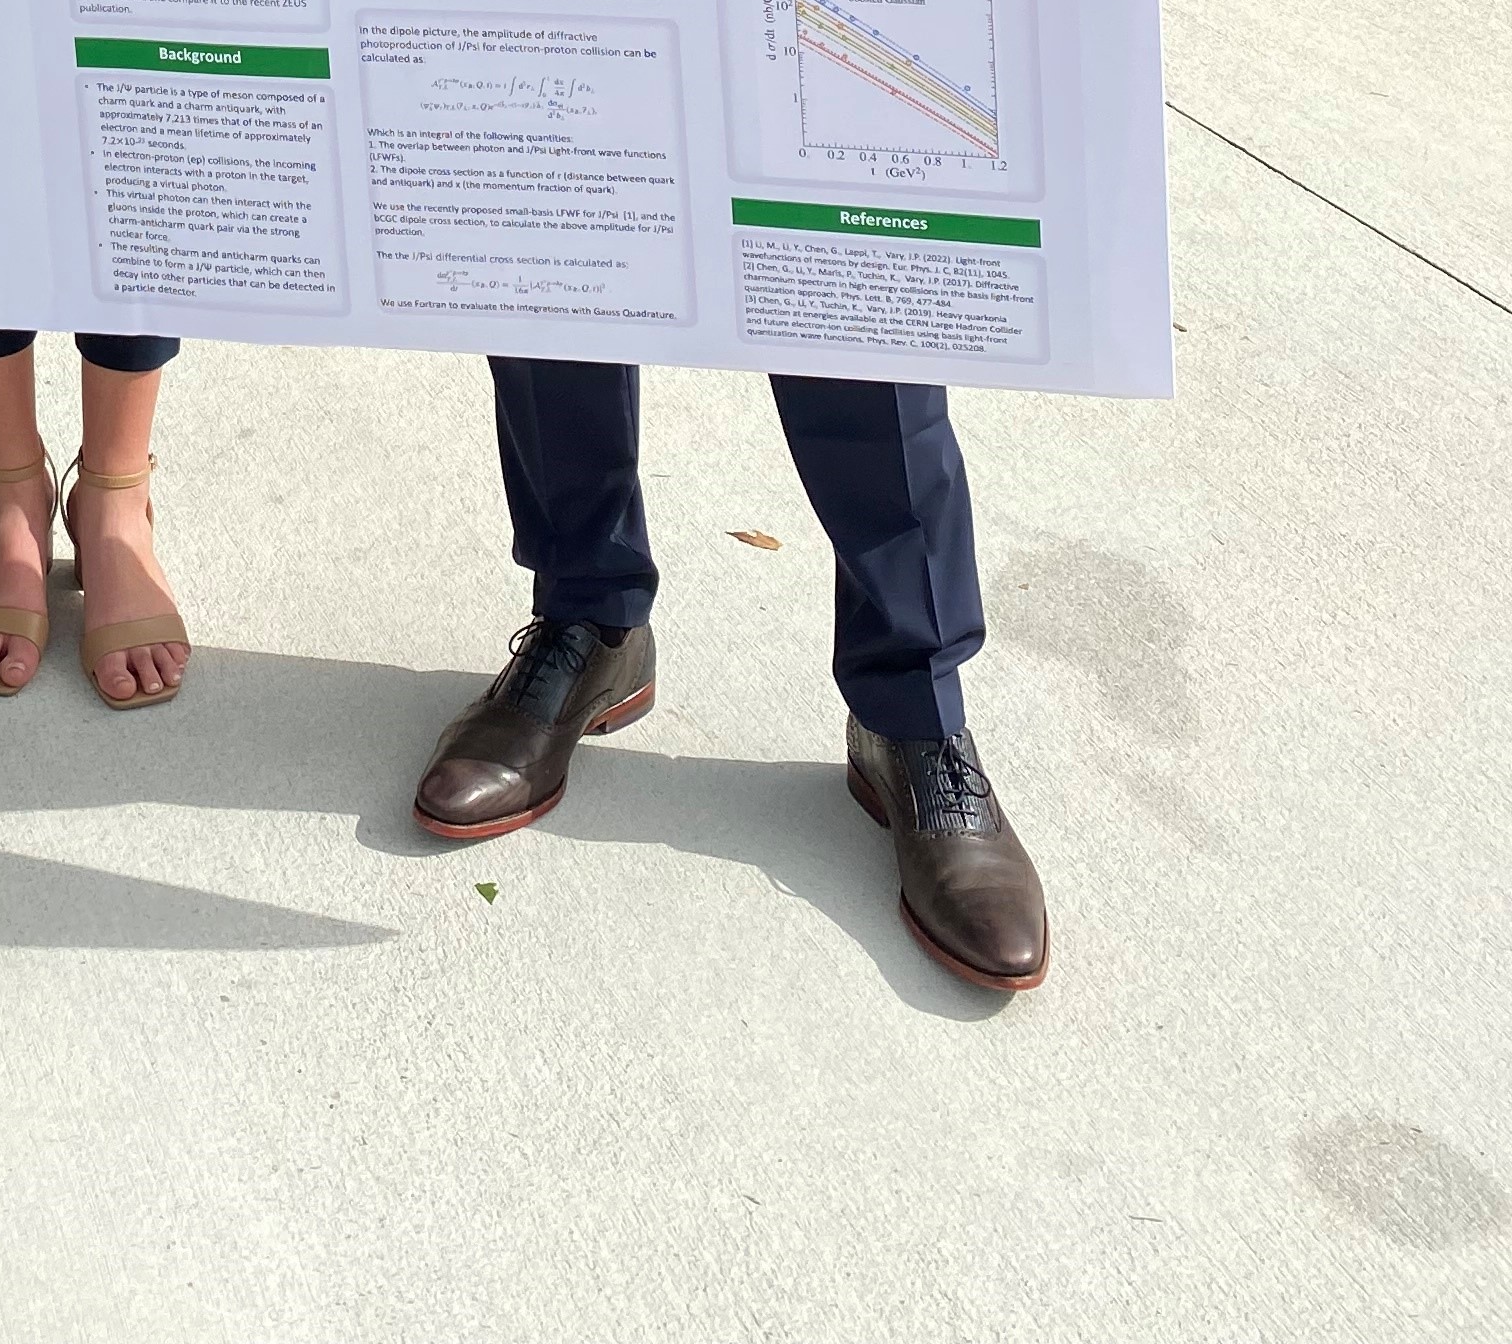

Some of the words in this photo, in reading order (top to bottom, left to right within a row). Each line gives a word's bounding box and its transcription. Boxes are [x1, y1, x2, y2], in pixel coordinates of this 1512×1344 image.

[158, 46, 242, 65] Background
[97, 95, 127, 106] charm
[128, 98, 156, 108] quark
[157, 100, 174, 110] and
[176, 102, 182, 110] a
[183, 101, 214, 112] charm
[264, 105, 286, 115] with
[826, 149, 845, 161] 0.2
[859, 151, 877, 162] 0.4
[891, 153, 910, 165] 0.6
[923, 155, 942, 167] 0.8
[991, 160, 1007, 171] 1.2
[840, 210, 928, 231] References
